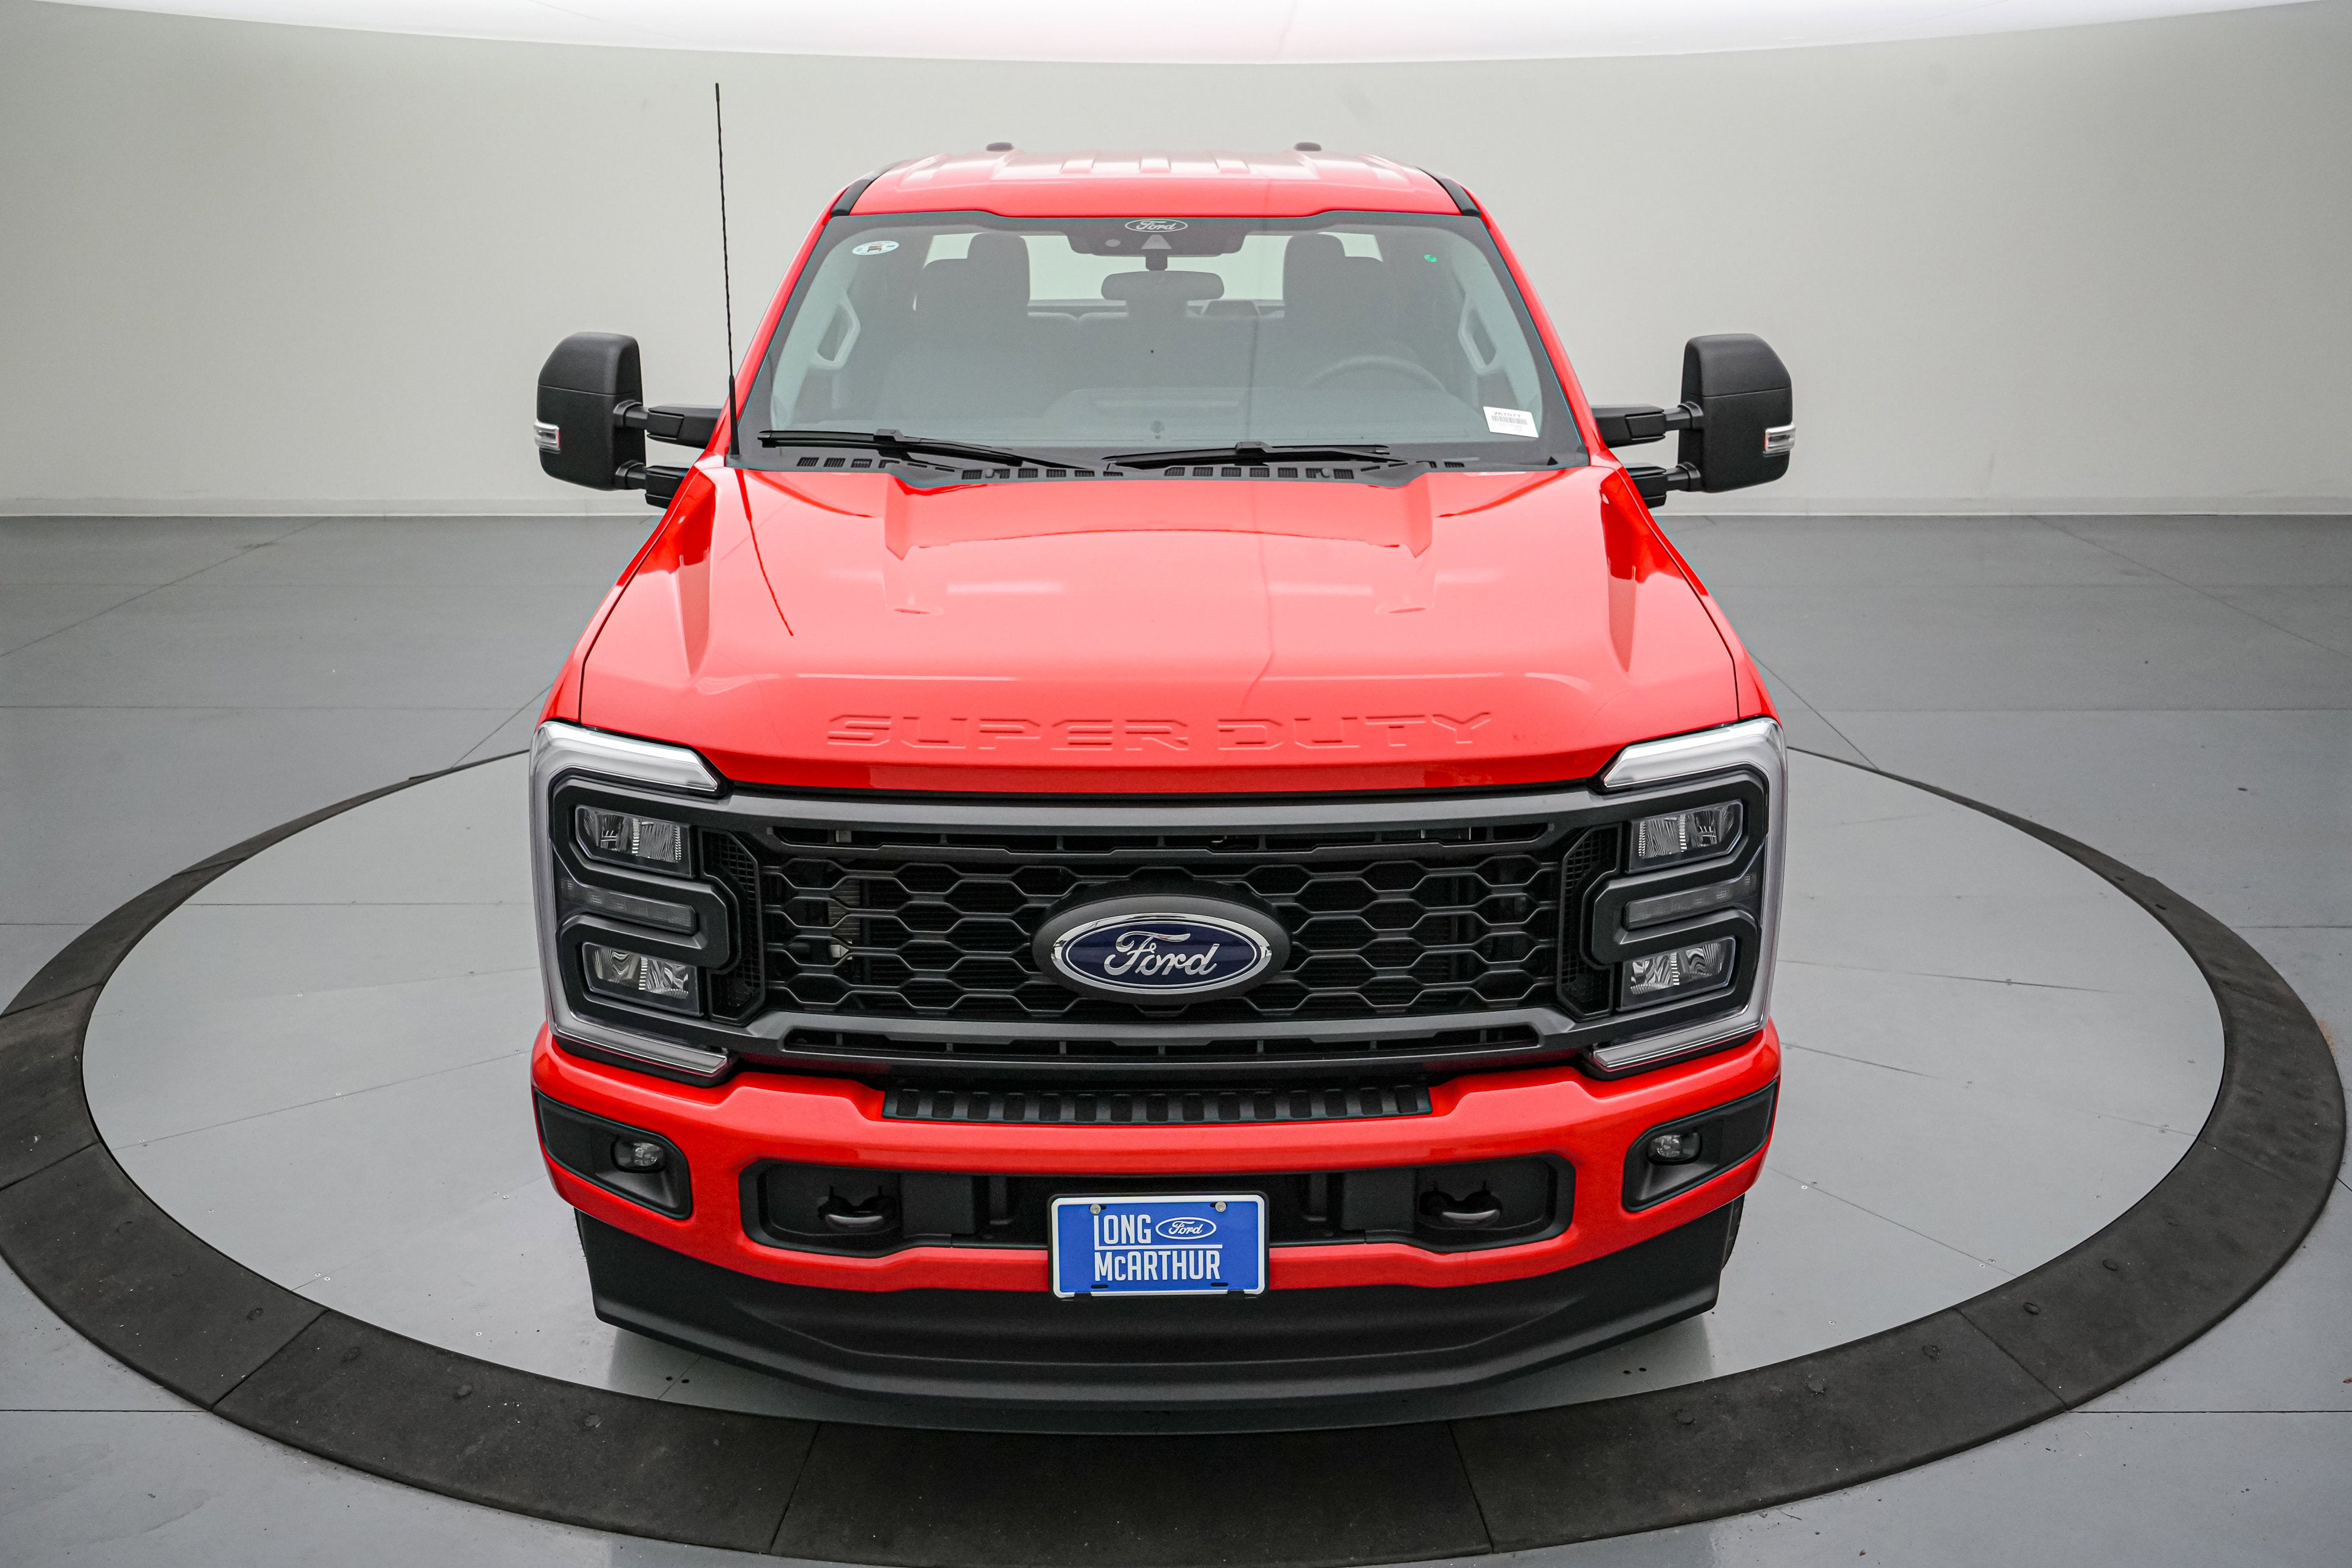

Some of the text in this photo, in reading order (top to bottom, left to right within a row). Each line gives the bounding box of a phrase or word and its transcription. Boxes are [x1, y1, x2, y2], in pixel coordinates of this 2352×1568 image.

[1135, 220, 1177, 230] Ford
[827, 711, 1492, 750] SUPER DUTY
[1104, 930, 1220, 976] Ford
[1093, 1214, 1204, 1251] LONG Ford
[1094, 1249, 1221, 1282] McARTHUR
